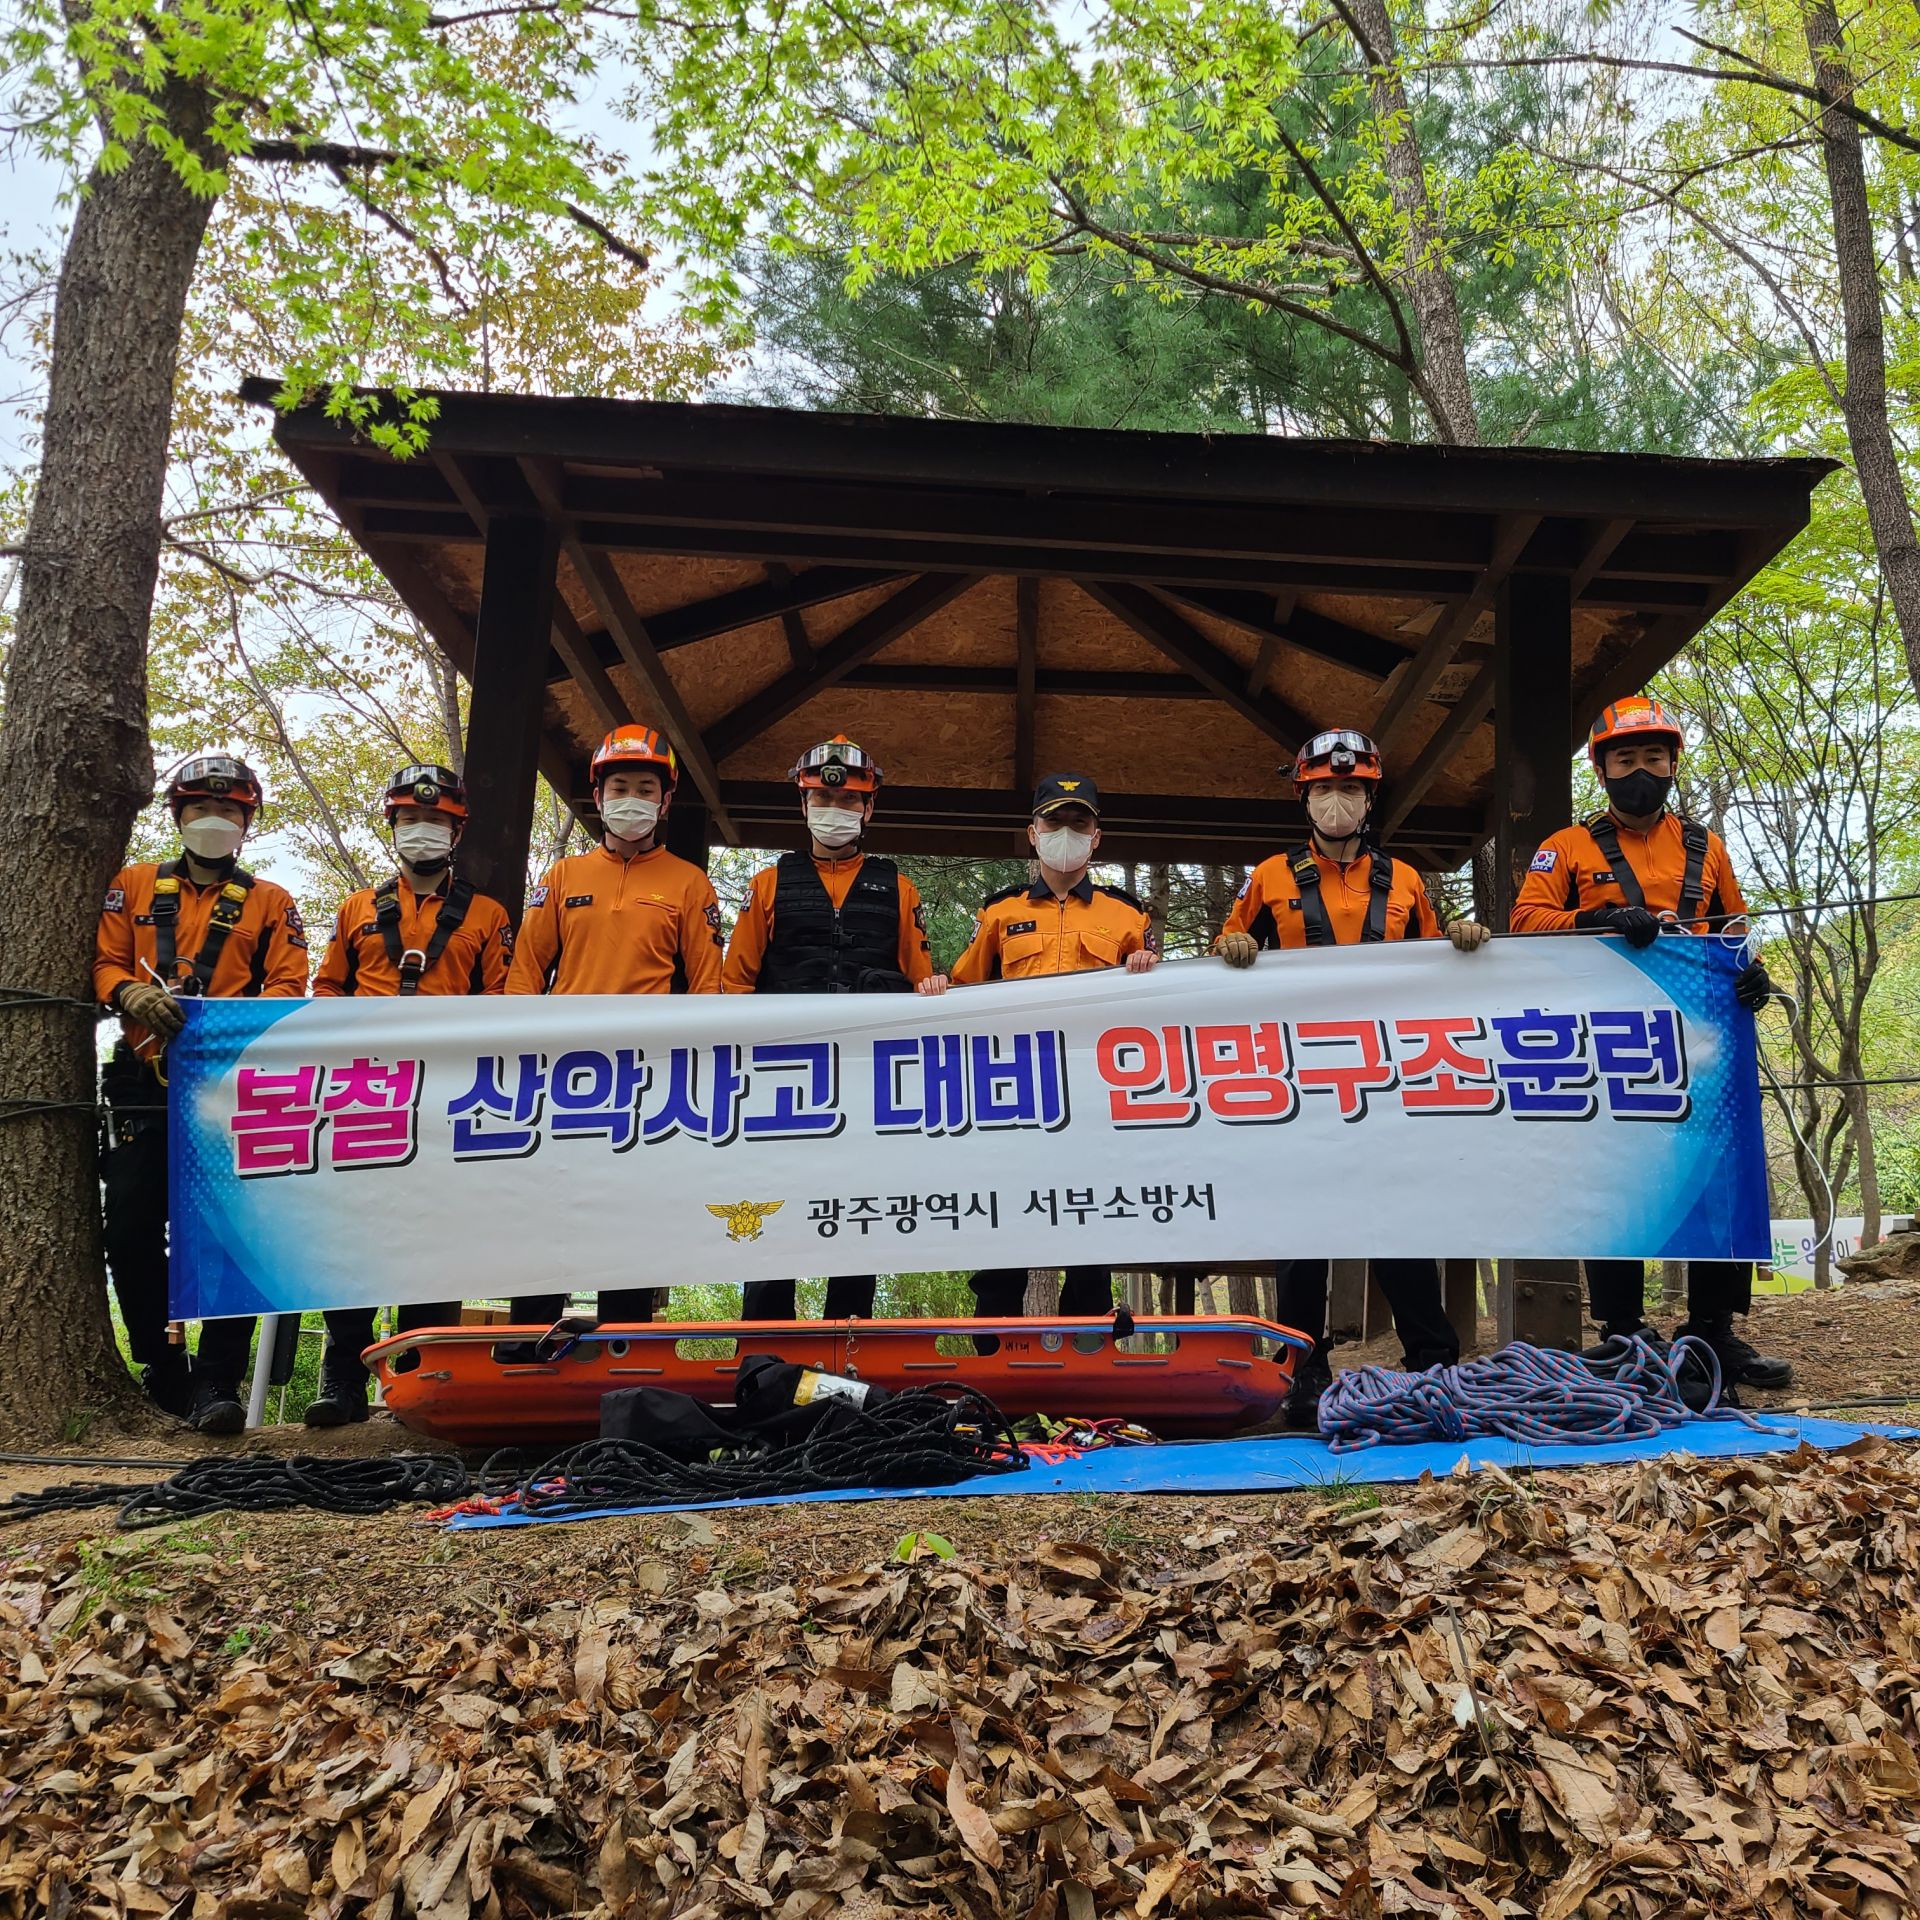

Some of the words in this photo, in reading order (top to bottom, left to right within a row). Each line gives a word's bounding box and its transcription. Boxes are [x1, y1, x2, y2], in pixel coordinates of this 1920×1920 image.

[231, 1056, 422, 1178] 봄철
[447, 1042, 846, 1162] 산악사고
[873, 1028, 1068, 1136] 대비
[1096, 1007, 1690, 1128] 인명구조훈련
[806, 1191, 999, 1238] 광주광역시
[1023, 1183, 1217, 1226] 서부소방서
